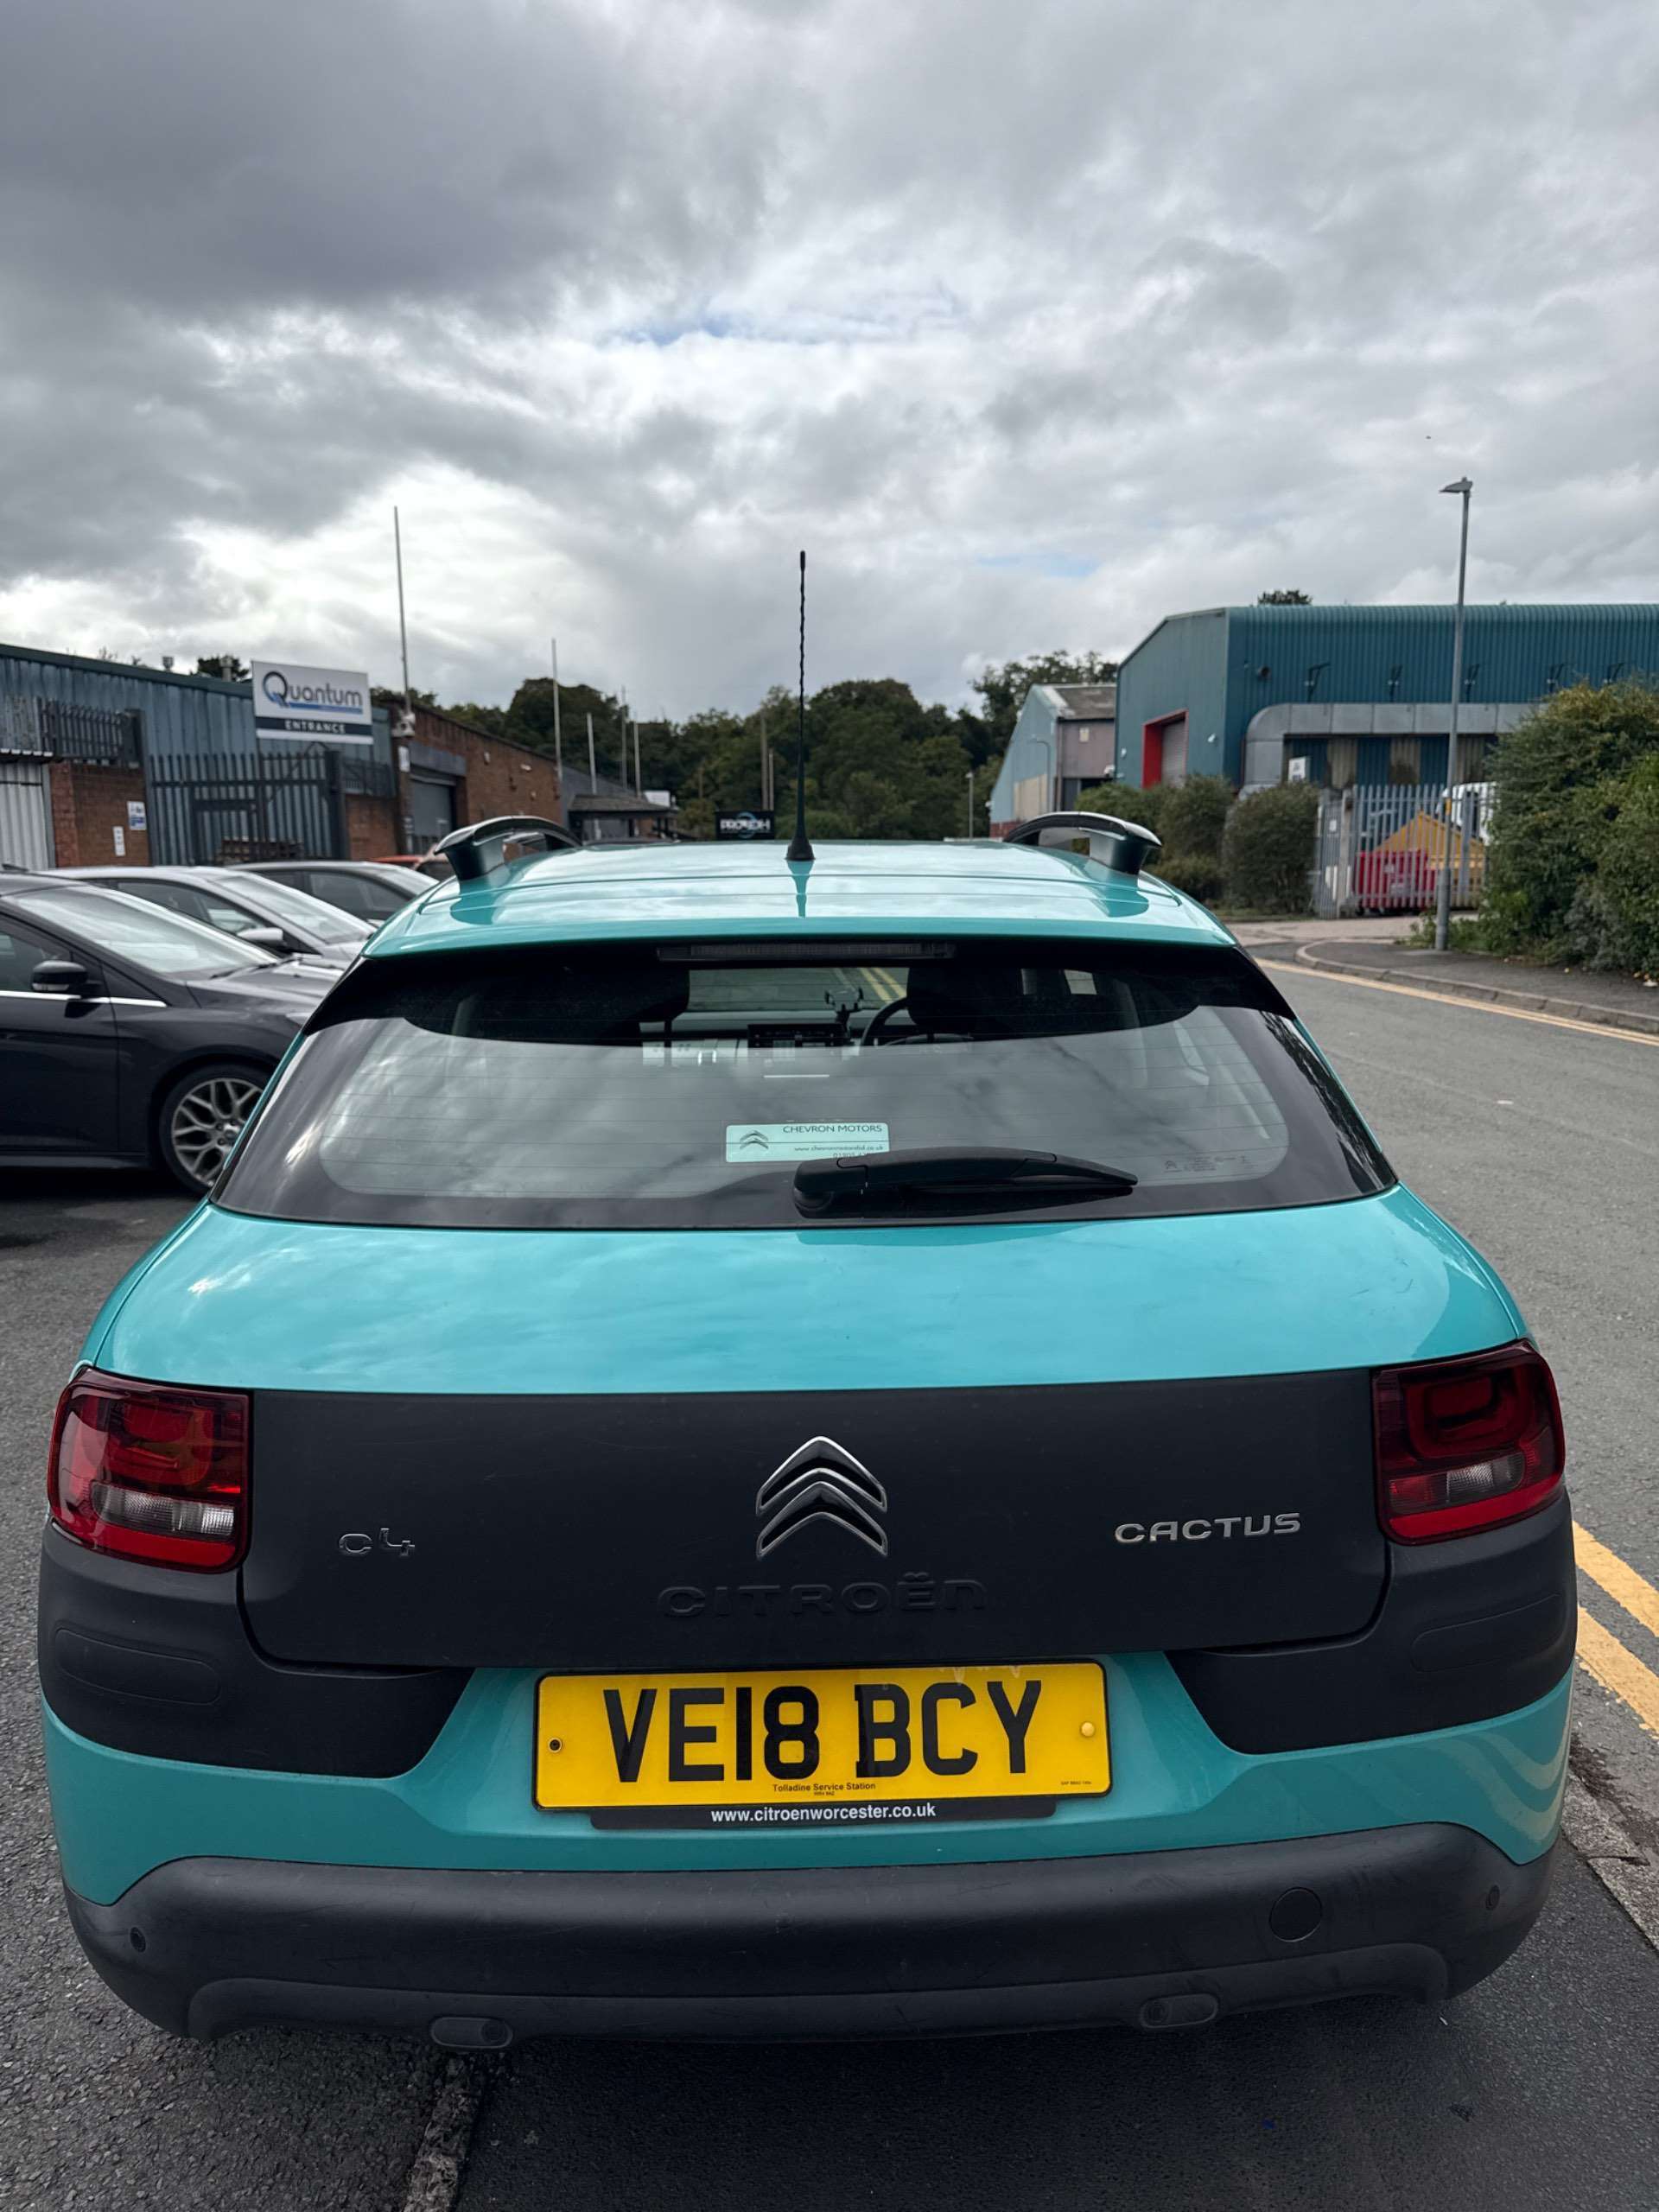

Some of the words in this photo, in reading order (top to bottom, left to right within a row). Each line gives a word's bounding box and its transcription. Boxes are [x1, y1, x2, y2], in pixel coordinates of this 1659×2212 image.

[263, 671, 363, 709] Quantum
[284, 721, 346, 734] ENTRANCE
[338, 1527, 416, 1556] C4
[1115, 1512, 1301, 1543] CACTUS
[602, 1685, 819, 1783] VE18
[854, 1679, 1042, 1778] BCY
[773, 1783, 810, 1792] Tolladine
[813, 1783, 844, 1791] Service
[846, 1782, 876, 1790] Station
[711, 1802, 936, 1822] www.citroenworcester.co.uk
